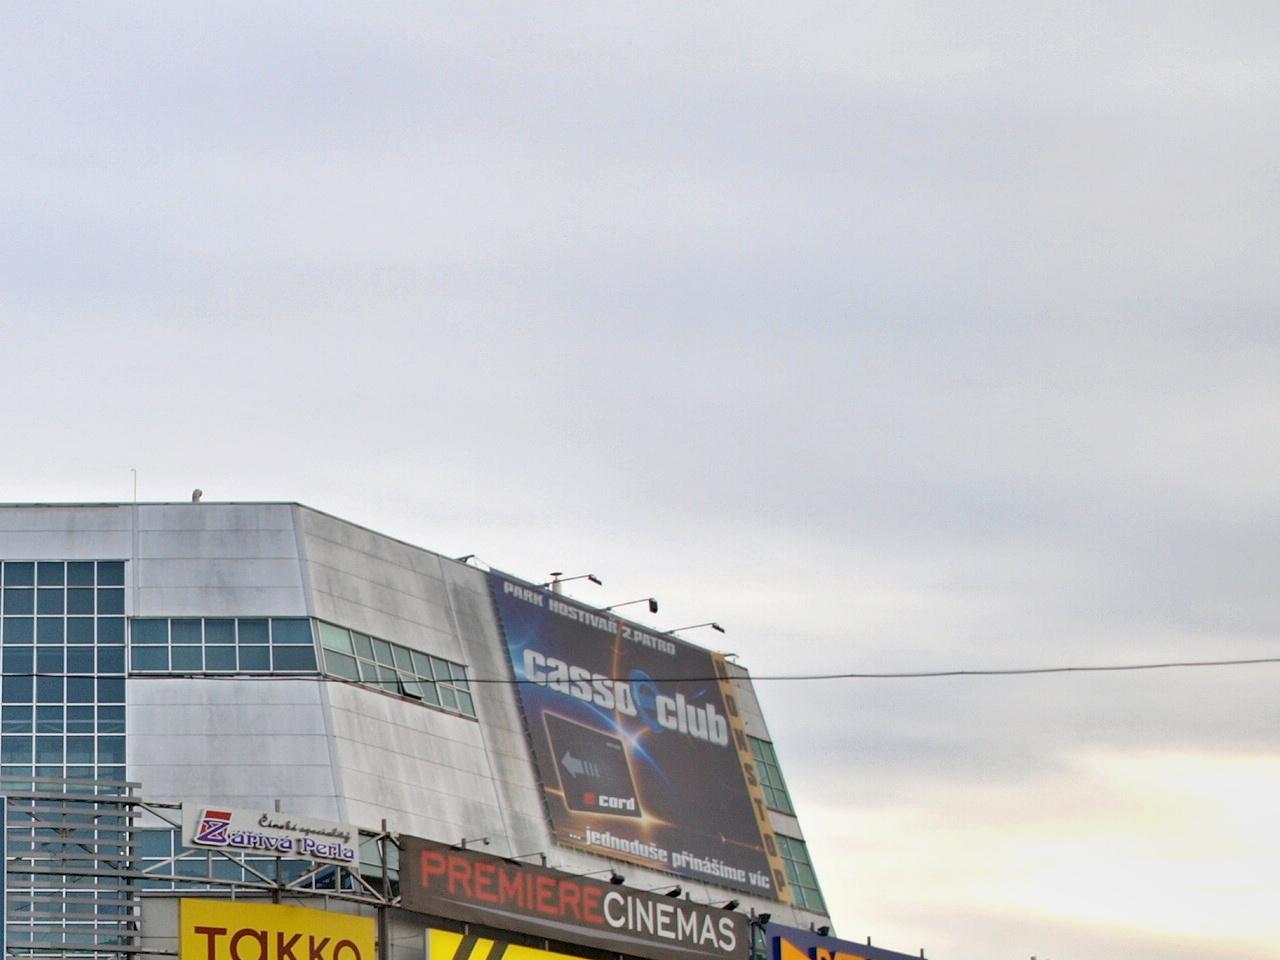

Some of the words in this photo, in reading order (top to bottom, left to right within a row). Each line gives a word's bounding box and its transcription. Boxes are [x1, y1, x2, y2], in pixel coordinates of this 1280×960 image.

[504, 581, 543, 608] PARK
[585, 826, 668, 863] jednoduše
[672, 851, 746, 883] přinášíme
[749, 870, 770, 888] víc
[603, 891, 737, 952] CINEMAS
